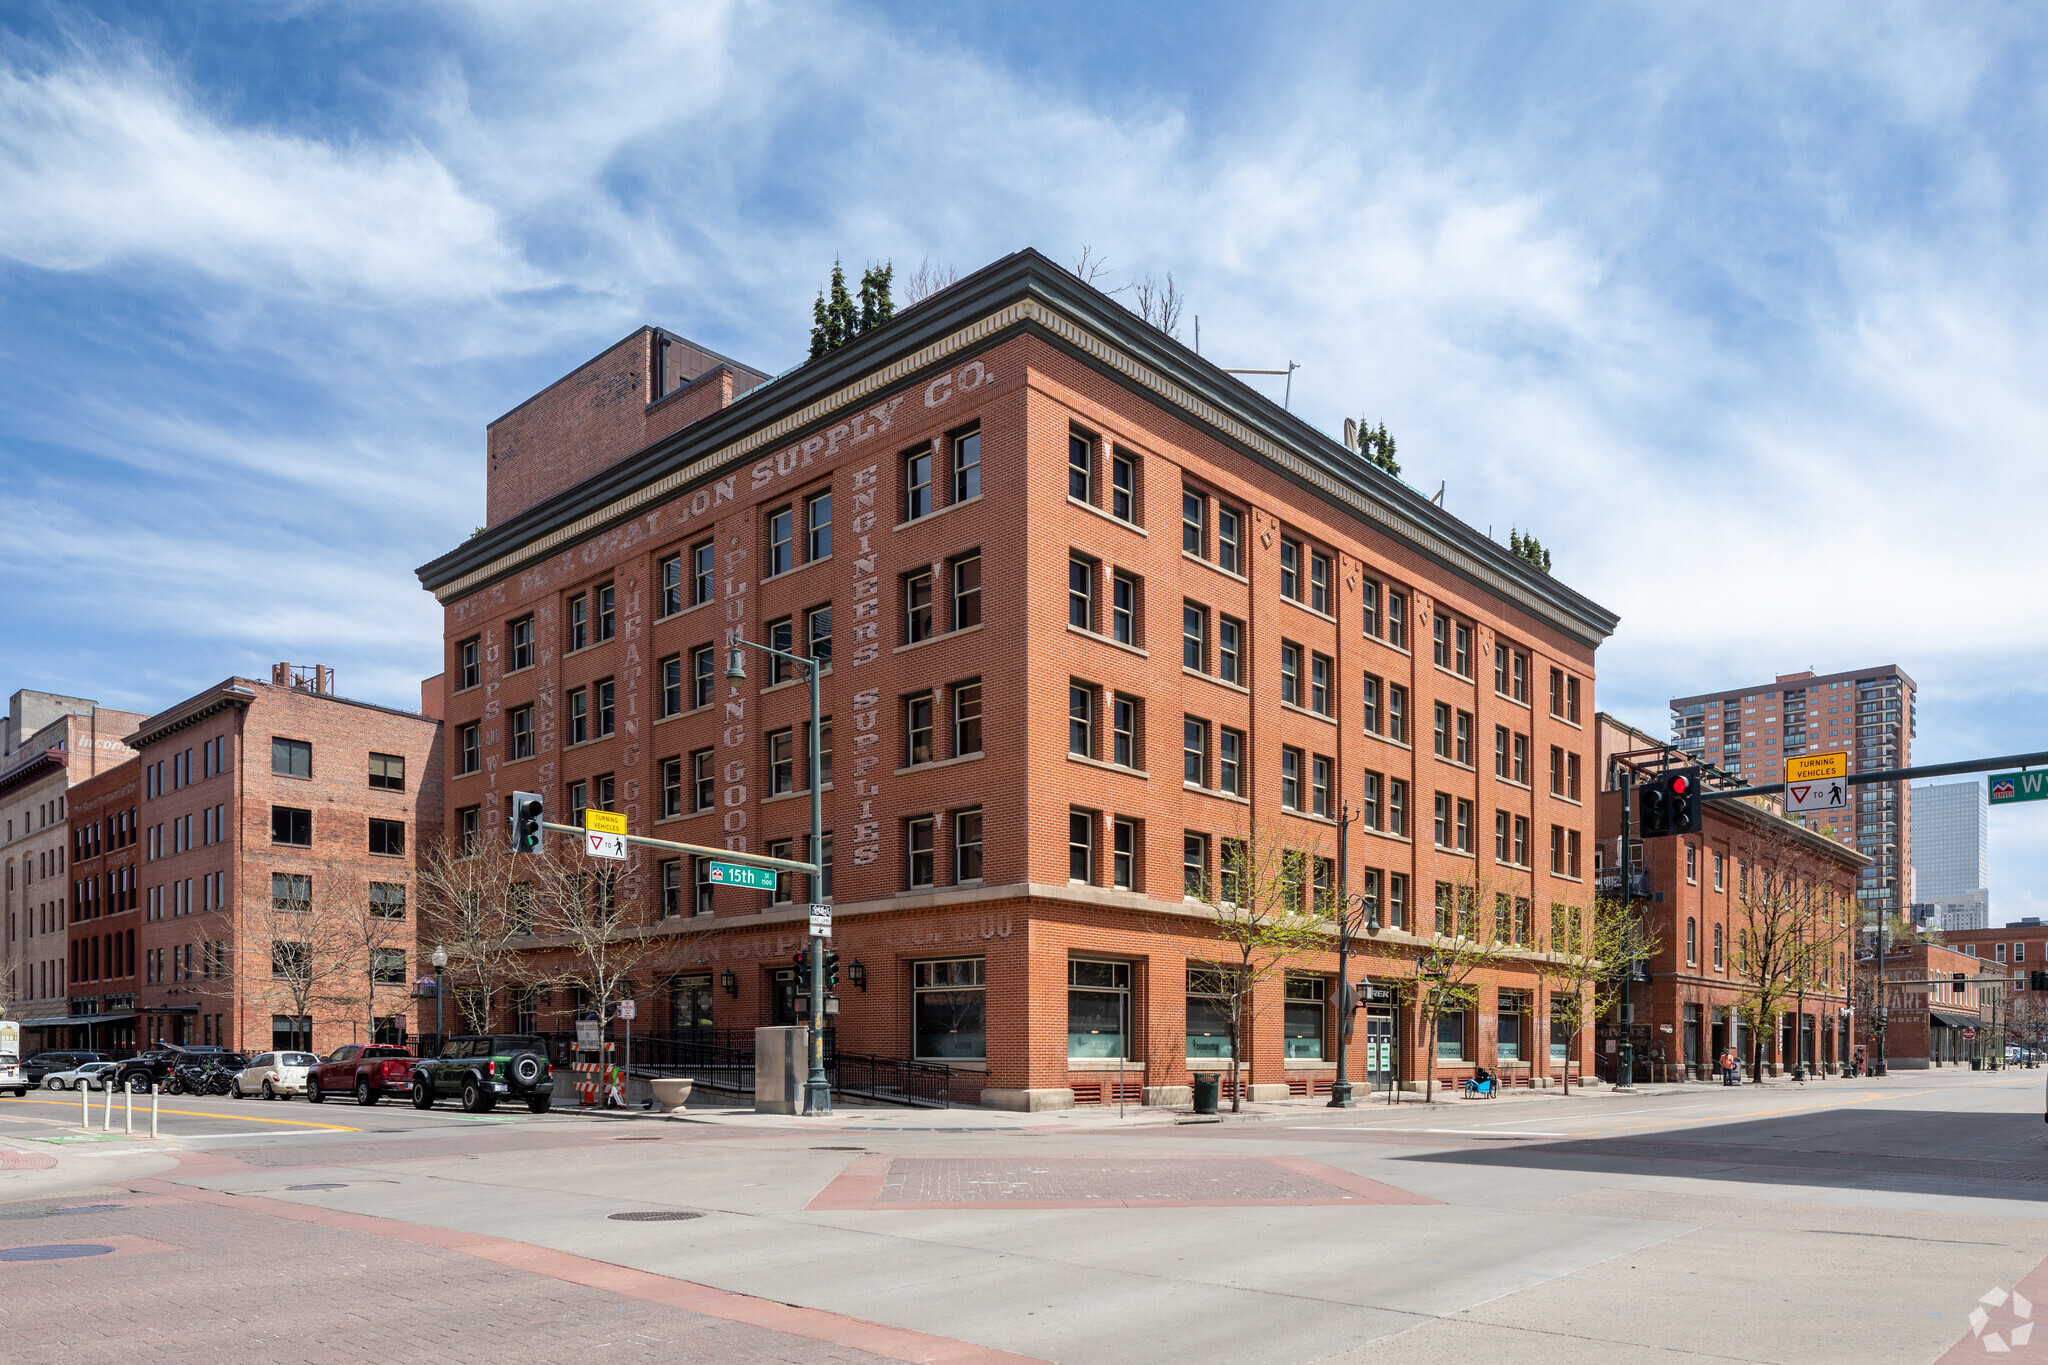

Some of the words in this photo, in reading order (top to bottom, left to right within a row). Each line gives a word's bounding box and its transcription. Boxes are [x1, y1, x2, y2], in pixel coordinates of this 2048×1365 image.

[751, 395, 905, 491] SUPPLY
[923, 359, 995, 410] CO.
[852, 464, 879, 668] ENGINEERS
[485, 628, 500, 720] PUMPS
[621, 588, 643, 768] HEATING
[1799, 757, 1835, 768] TURNING
[851, 687, 880, 867] SUPPLIES
[1797, 767, 1837, 778] VEHICLES
[2021, 773, 2048, 794] W
[1813, 791, 1824, 799] TO
[594, 814, 619, 824] TURNING
[593, 822, 620, 832] VEHICLES
[604, 841, 612, 849] TO
[728, 867, 755, 885] 15th
[760, 878, 773, 887] 1500
[1370, 988, 1390, 999] REK
